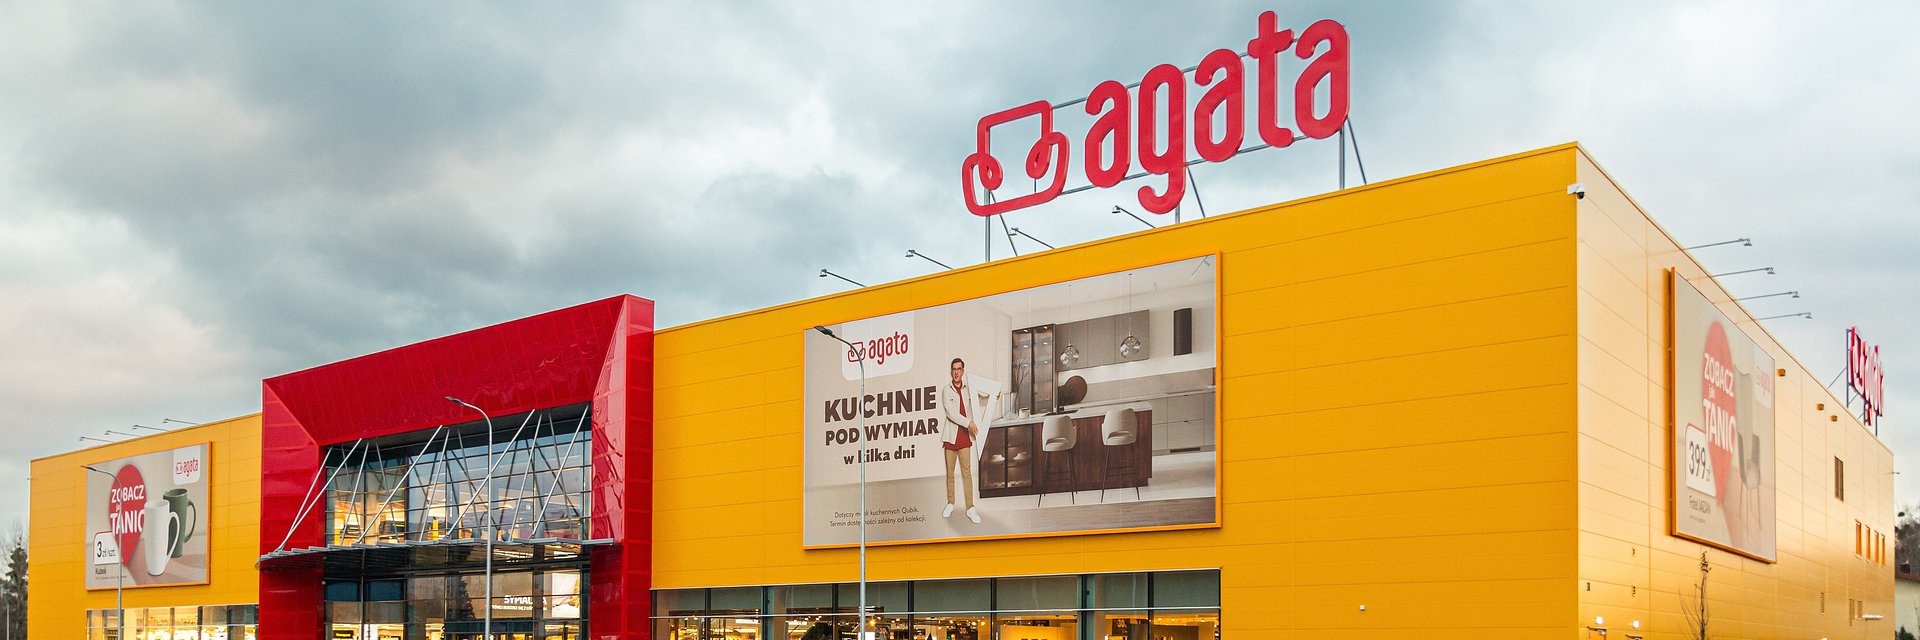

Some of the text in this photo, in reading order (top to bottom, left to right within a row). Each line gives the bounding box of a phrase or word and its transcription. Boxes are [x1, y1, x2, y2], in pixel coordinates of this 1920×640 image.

[1085, 10, 1350, 214] agata
[869, 331, 909, 365] agata
[1703, 352, 1734, 397] ZOBACZ
[824, 386, 937, 423] KUCHNIE
[825, 418, 939, 446] POD WYMIAR
[1702, 398, 1737, 454] TANIO
[183, 457, 199, 477] agata
[844, 455, 854, 465] w
[894, 445, 915, 460] dni
[1688, 440, 1706, 480] 399
[111, 484, 145, 504] ZOBACZ
[834, 511, 854, 519] Dotyczy
[870, 507, 900, 516] kuchennych
[847, 518, 877, 527] dostęności
[877, 516, 896, 525] zależny
[96, 541, 103, 558] 3
